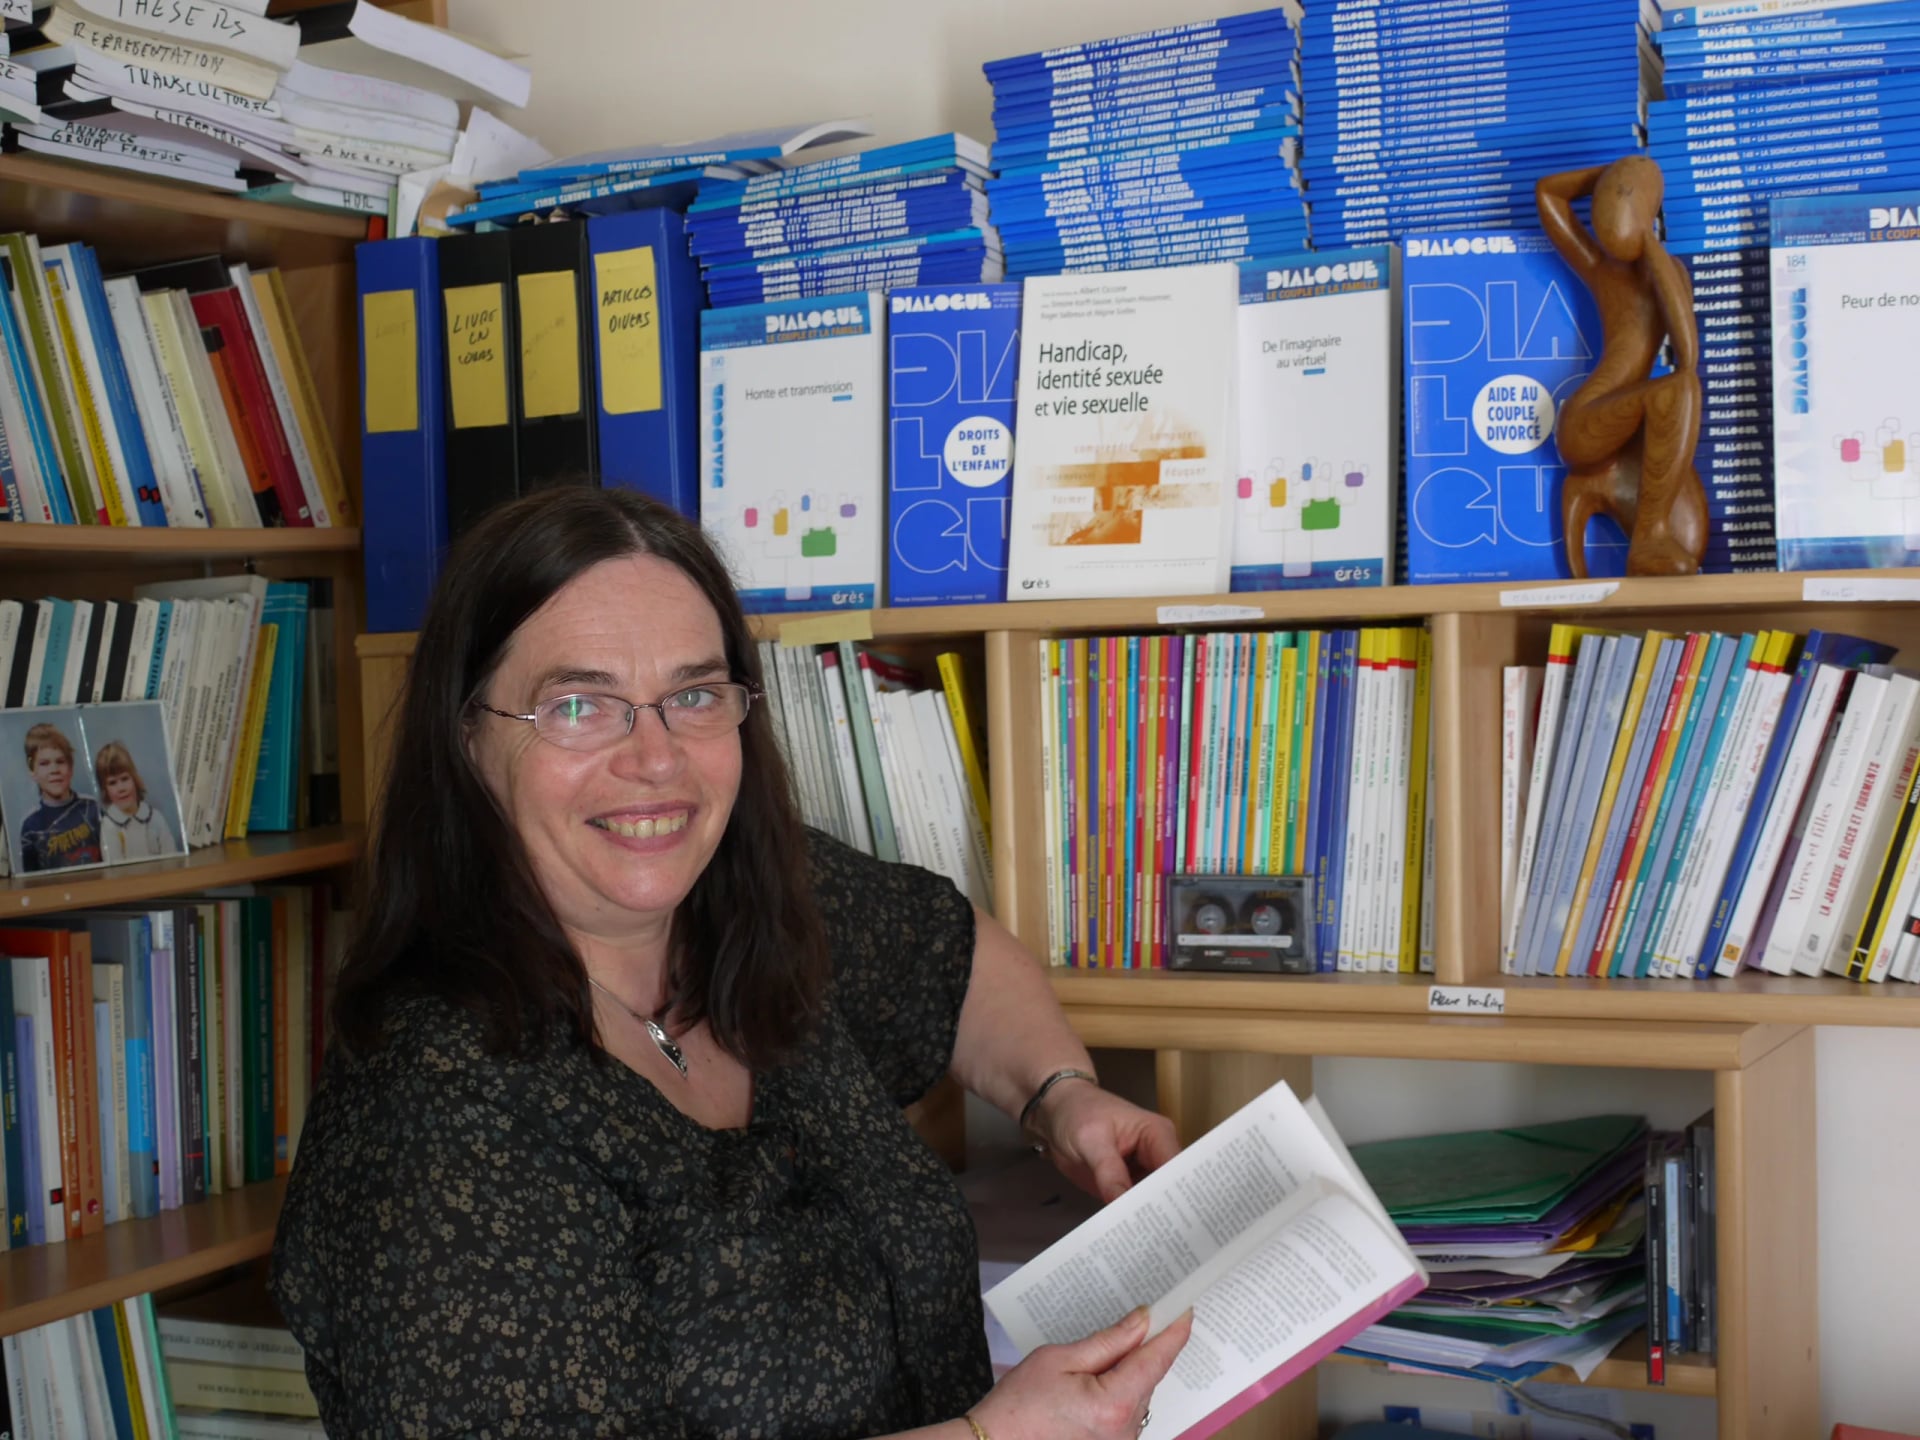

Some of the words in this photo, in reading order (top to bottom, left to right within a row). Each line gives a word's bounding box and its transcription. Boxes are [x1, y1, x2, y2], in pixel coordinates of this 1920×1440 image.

[1705, 52, 1756, 64] DIALOGUE
[1686, 95, 1735, 108] DIALOGUE
[1687, 123, 1736, 136] DIALOGUE
[1702, 194, 1751, 206] DIALOGUE
[1871, 232, 1882, 240] LE
[1887, 228, 1920, 240] COUP
[1407, 236, 1517, 257] DIALOGUE
[1693, 253, 1742, 264] DIALOGUE
[1266, 260, 1378, 290] DIALOGUE
[1694, 268, 1743, 280] DIALOGUE
[1280, 287, 1313, 299] COUPLE
[1315, 286, 1326, 295] ET
[1328, 285, 1339, 294] LA
[1342, 280, 1378, 292] FAMILLE
[892, 293, 992, 313] DIALOGUE
[1842, 294, 1874, 309] Peur
[1877, 292, 1896, 307] de
[766, 306, 863, 333] DIALOGUE
[1039, 339, 1127, 366] Handicap,
[1262, 341, 1277, 353] De
[1280, 335, 1341, 351] l'imaginaire
[1791, 288, 1809, 414] DIALOGUE
[1277, 359, 1290, 368] au
[1293, 352, 1326, 366] virtuel
[1036, 367, 1101, 390] identité
[1106, 364, 1163, 387] sexuée
[746, 388, 775, 400] Honte
[778, 388, 787, 397] et
[790, 382, 853, 396] transmission
[1489, 387, 1516, 402] AIDE
[1521, 386, 1538, 401] AU
[1035, 402, 1048, 417] et
[1053, 396, 1077, 415] vie
[1081, 392, 1149, 414] sexuelle
[1488, 405, 1539, 423] COUPLE,
[712, 384, 724, 488] DIALOGUE
[958, 429, 1000, 441] DROITS
[1487, 425, 1541, 441] DIVORCE
[972, 445, 986, 455] DE
[952, 459, 1006, 471] L'ENFANT
[1335, 565, 1370, 582] érès
[832, 590, 864, 605] érès
[1853, 762, 1879, 811] TOURMENTS
[1810, 803, 1833, 838] filles
[1849, 815, 1860, 824] ET
[1807, 843, 1818, 857] et
[1838, 828, 1858, 860] DÉLICES
[1789, 861, 1815, 900] Mères
[1819, 905, 1831, 915] LA
